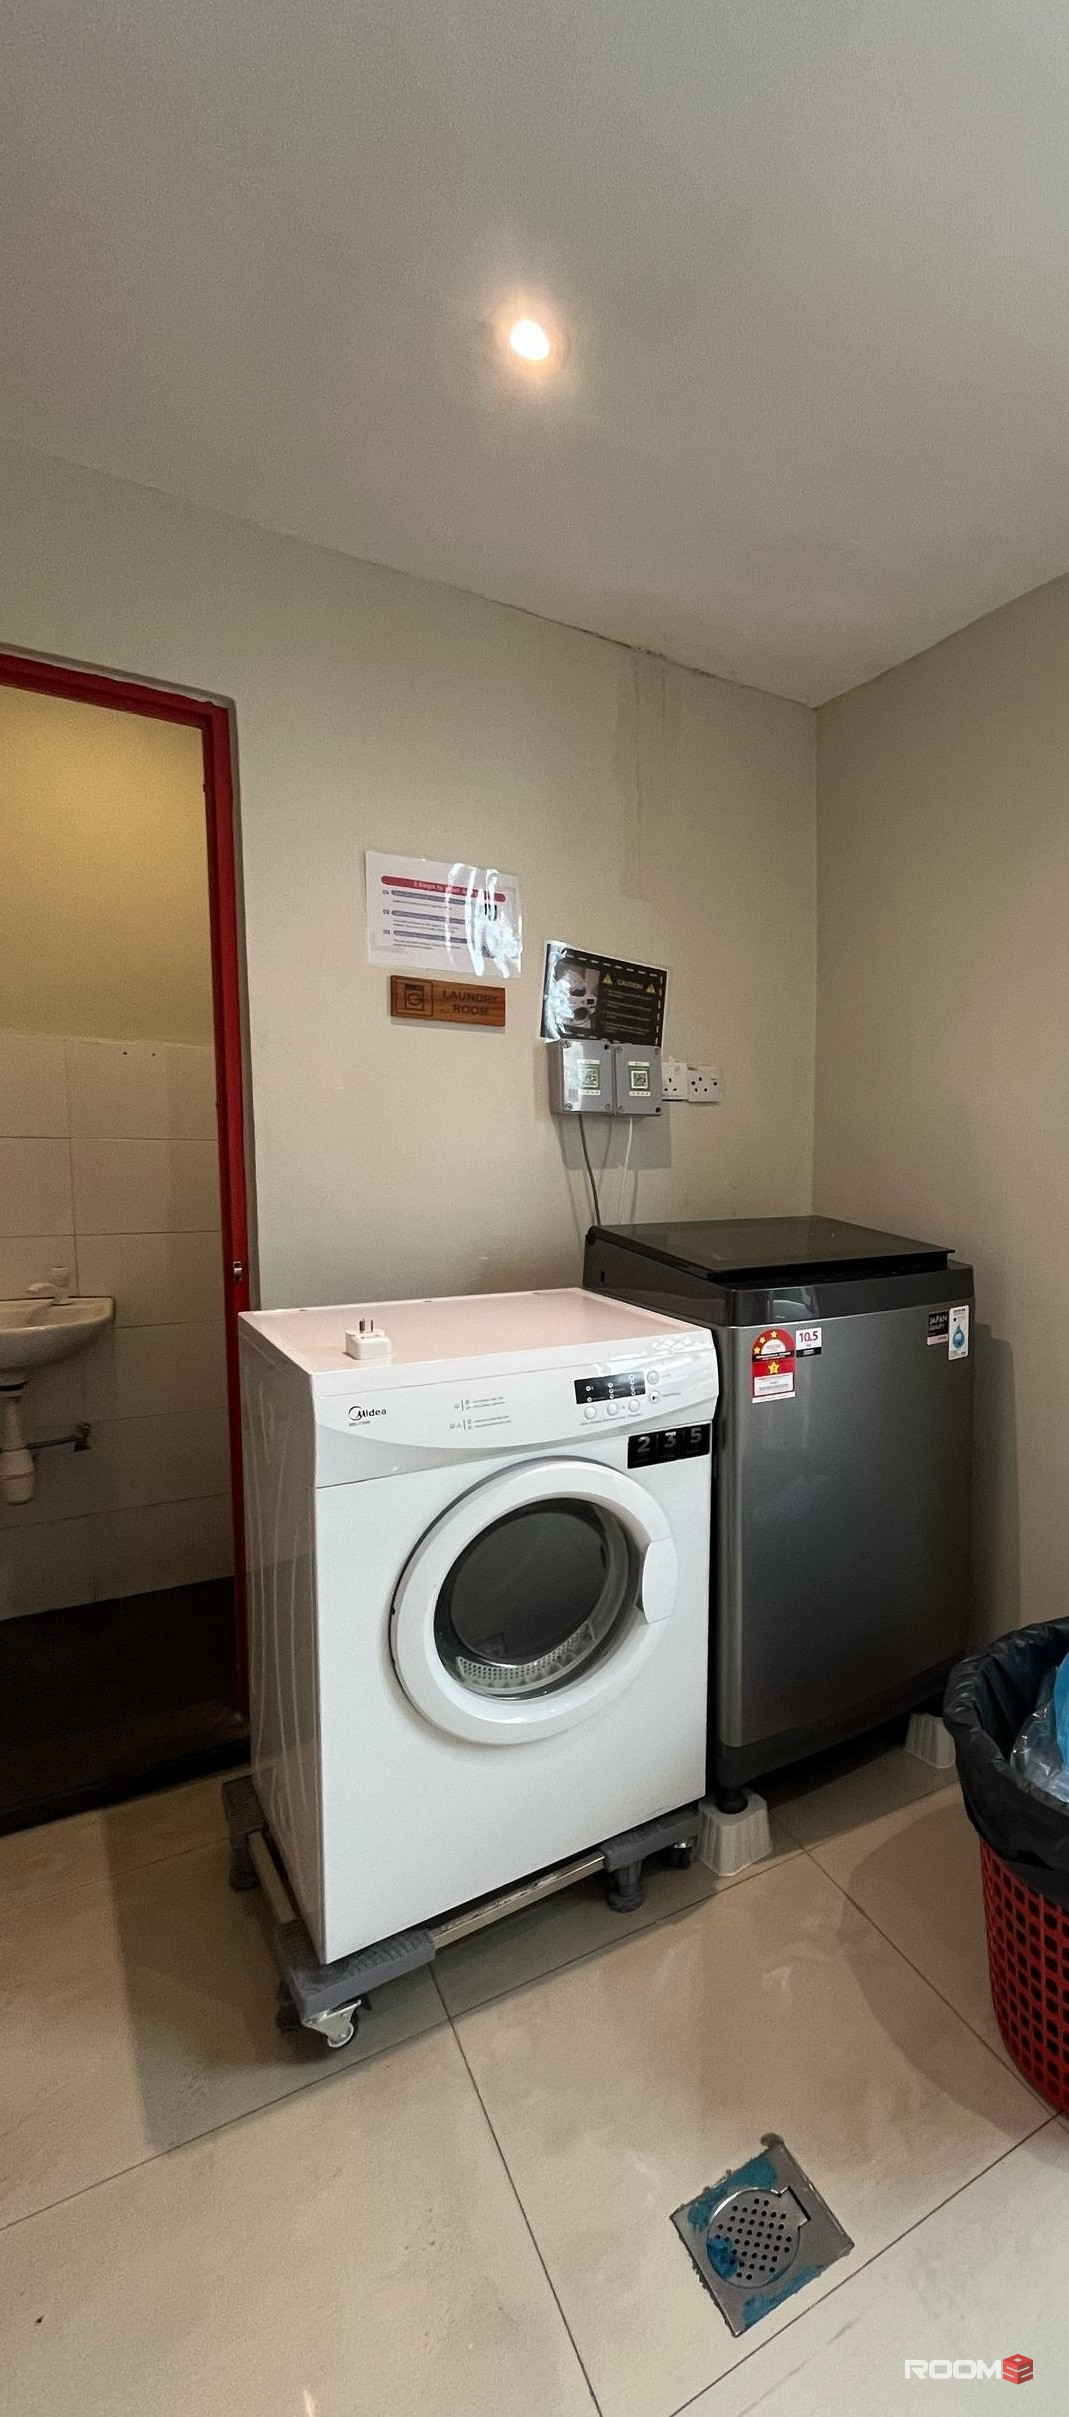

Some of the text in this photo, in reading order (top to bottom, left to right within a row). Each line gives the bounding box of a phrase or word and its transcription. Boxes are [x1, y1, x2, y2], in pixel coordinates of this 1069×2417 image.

[443, 989, 498, 1003] LAUNDRY
[453, 1004, 488, 1015] ROOM
[799, 1331, 818, 1342] 10.5
[349, 1406, 387, 1421] Midea
[637, 1427, 702, 1453] 2 3 5
